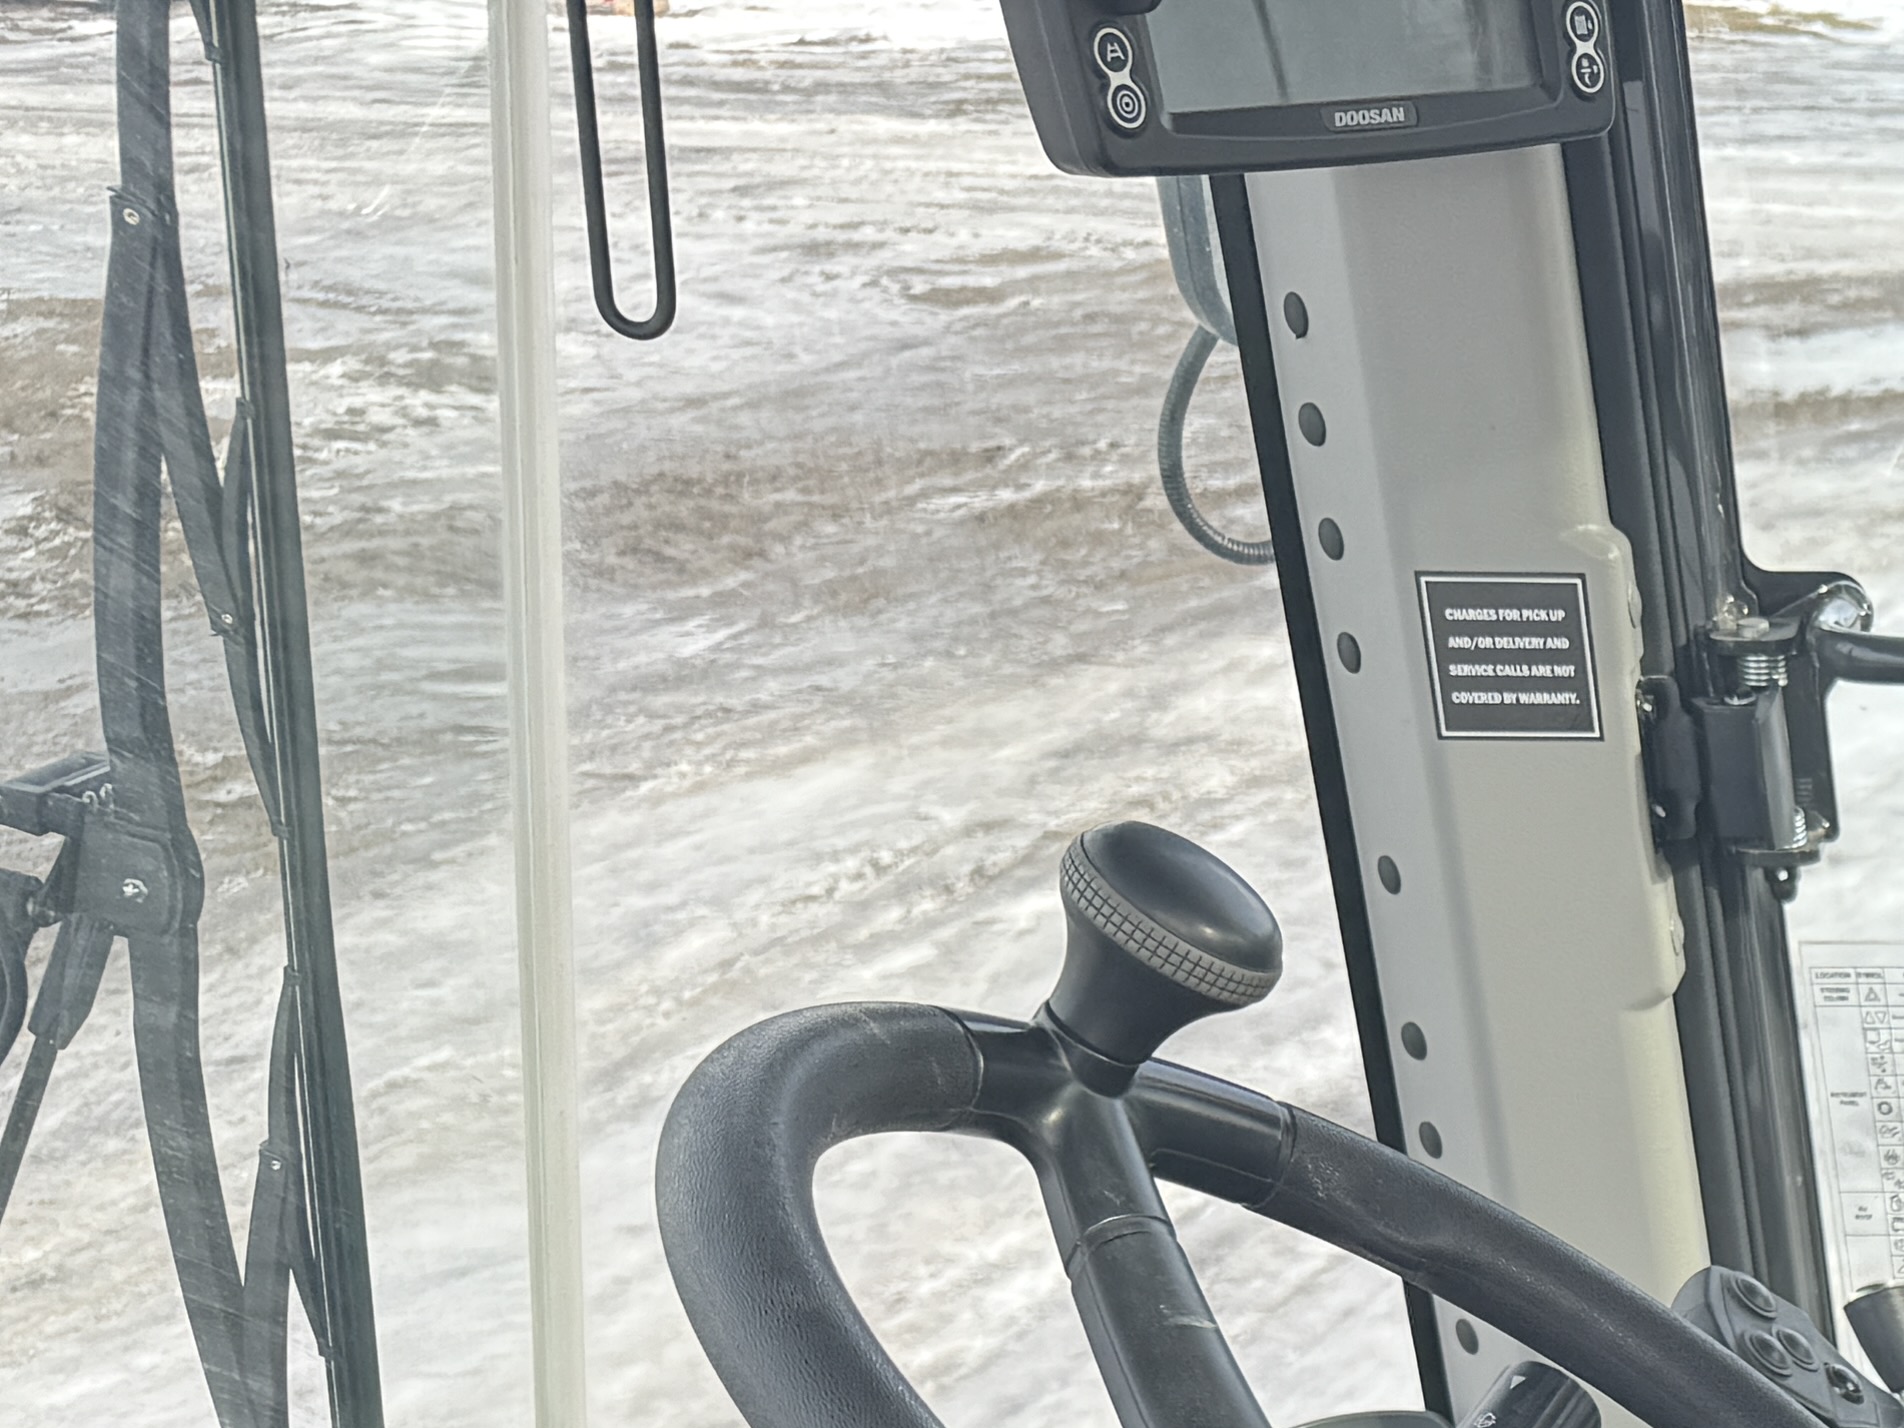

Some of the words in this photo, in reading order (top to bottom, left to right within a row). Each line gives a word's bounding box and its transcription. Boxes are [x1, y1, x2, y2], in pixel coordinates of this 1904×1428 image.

[1333, 107, 1406, 128] DOOSAN
[1445, 608, 1497, 621] CHARGES
[1499, 609, 1520, 621] FOR
[1522, 609, 1548, 621] PICK
[1549, 609, 1566, 621] UP
[1448, 636, 1494, 650] AND/OR
[1495, 637, 1545, 650] DELIVERY
[1546, 637, 1570, 649] AND
[1449, 664, 1495, 677] SERVICE
[1496, 664, 1529, 677] CALLS
[1531, 664, 1552, 677] ARE
[1553, 664, 1575, 677] NOT
[1451, 692, 1502, 704] COVERED
[1503, 692, 1518, 704] BY
